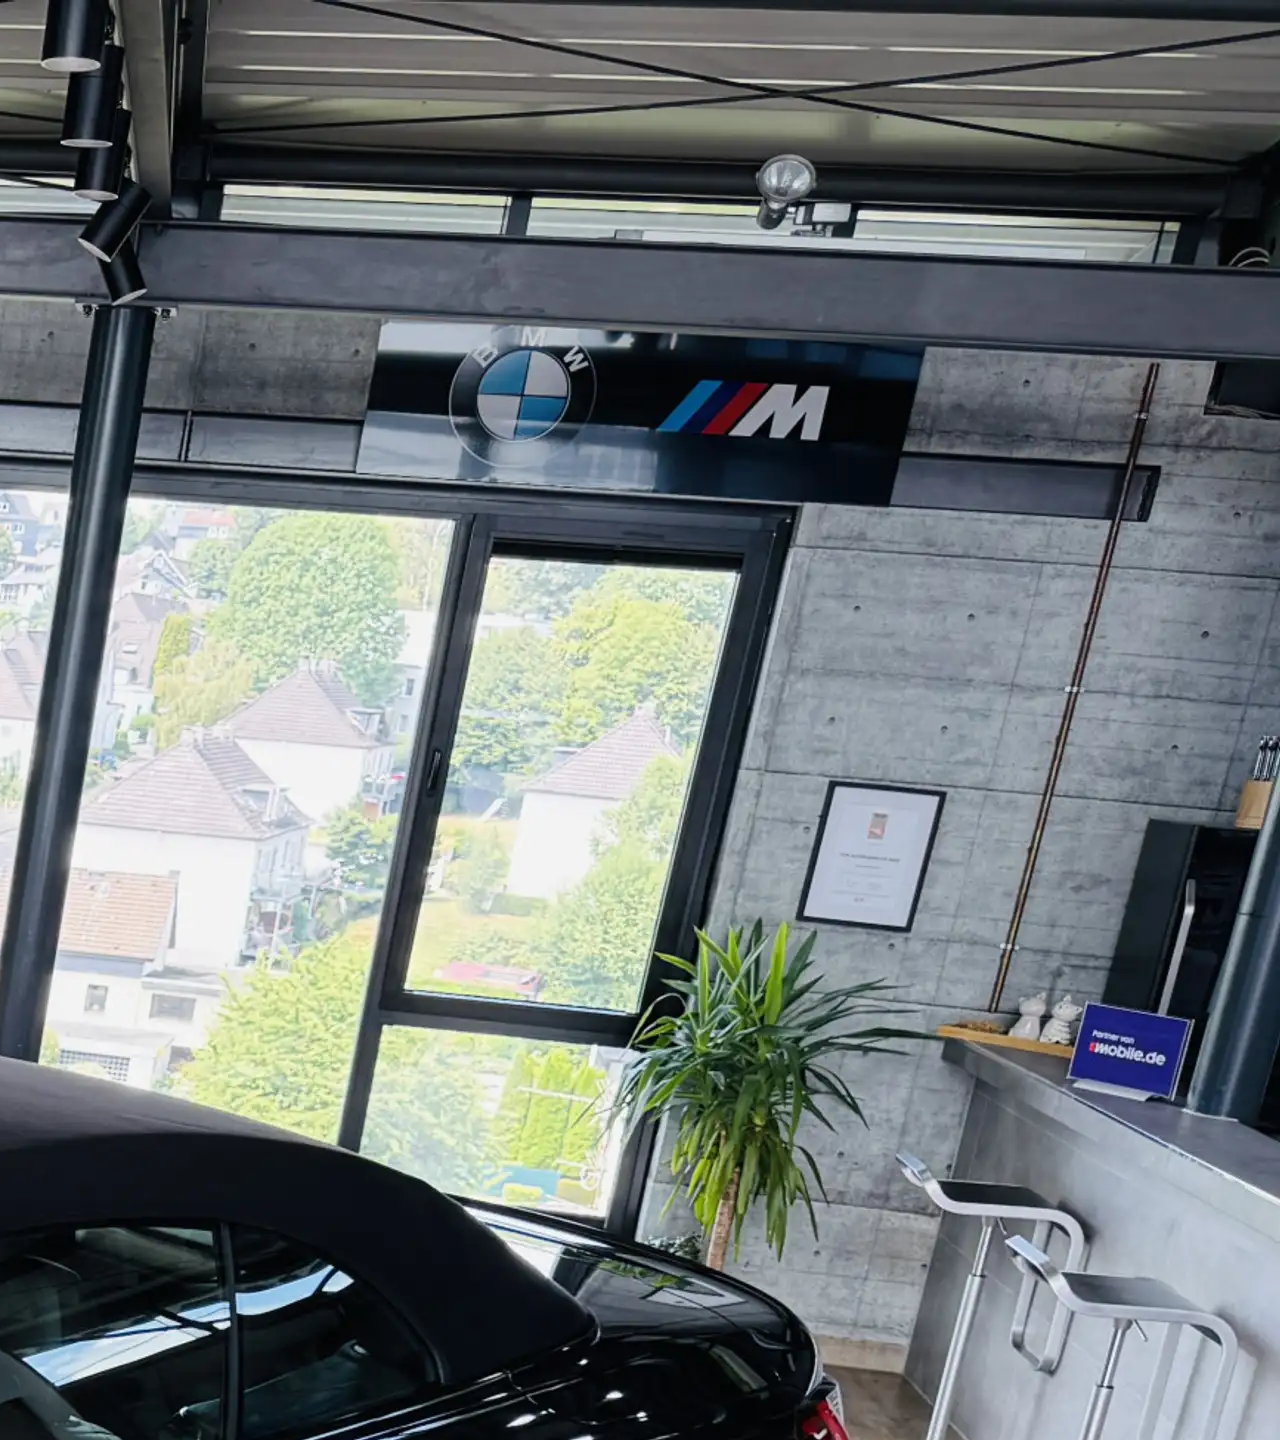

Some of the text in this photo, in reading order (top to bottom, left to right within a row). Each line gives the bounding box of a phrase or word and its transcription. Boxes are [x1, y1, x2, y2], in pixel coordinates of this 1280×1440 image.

[471, 326, 588, 372] BMW
[1092, 1029, 1120, 1042] Partner
[1093, 1042, 1166, 1066] mobile.de
